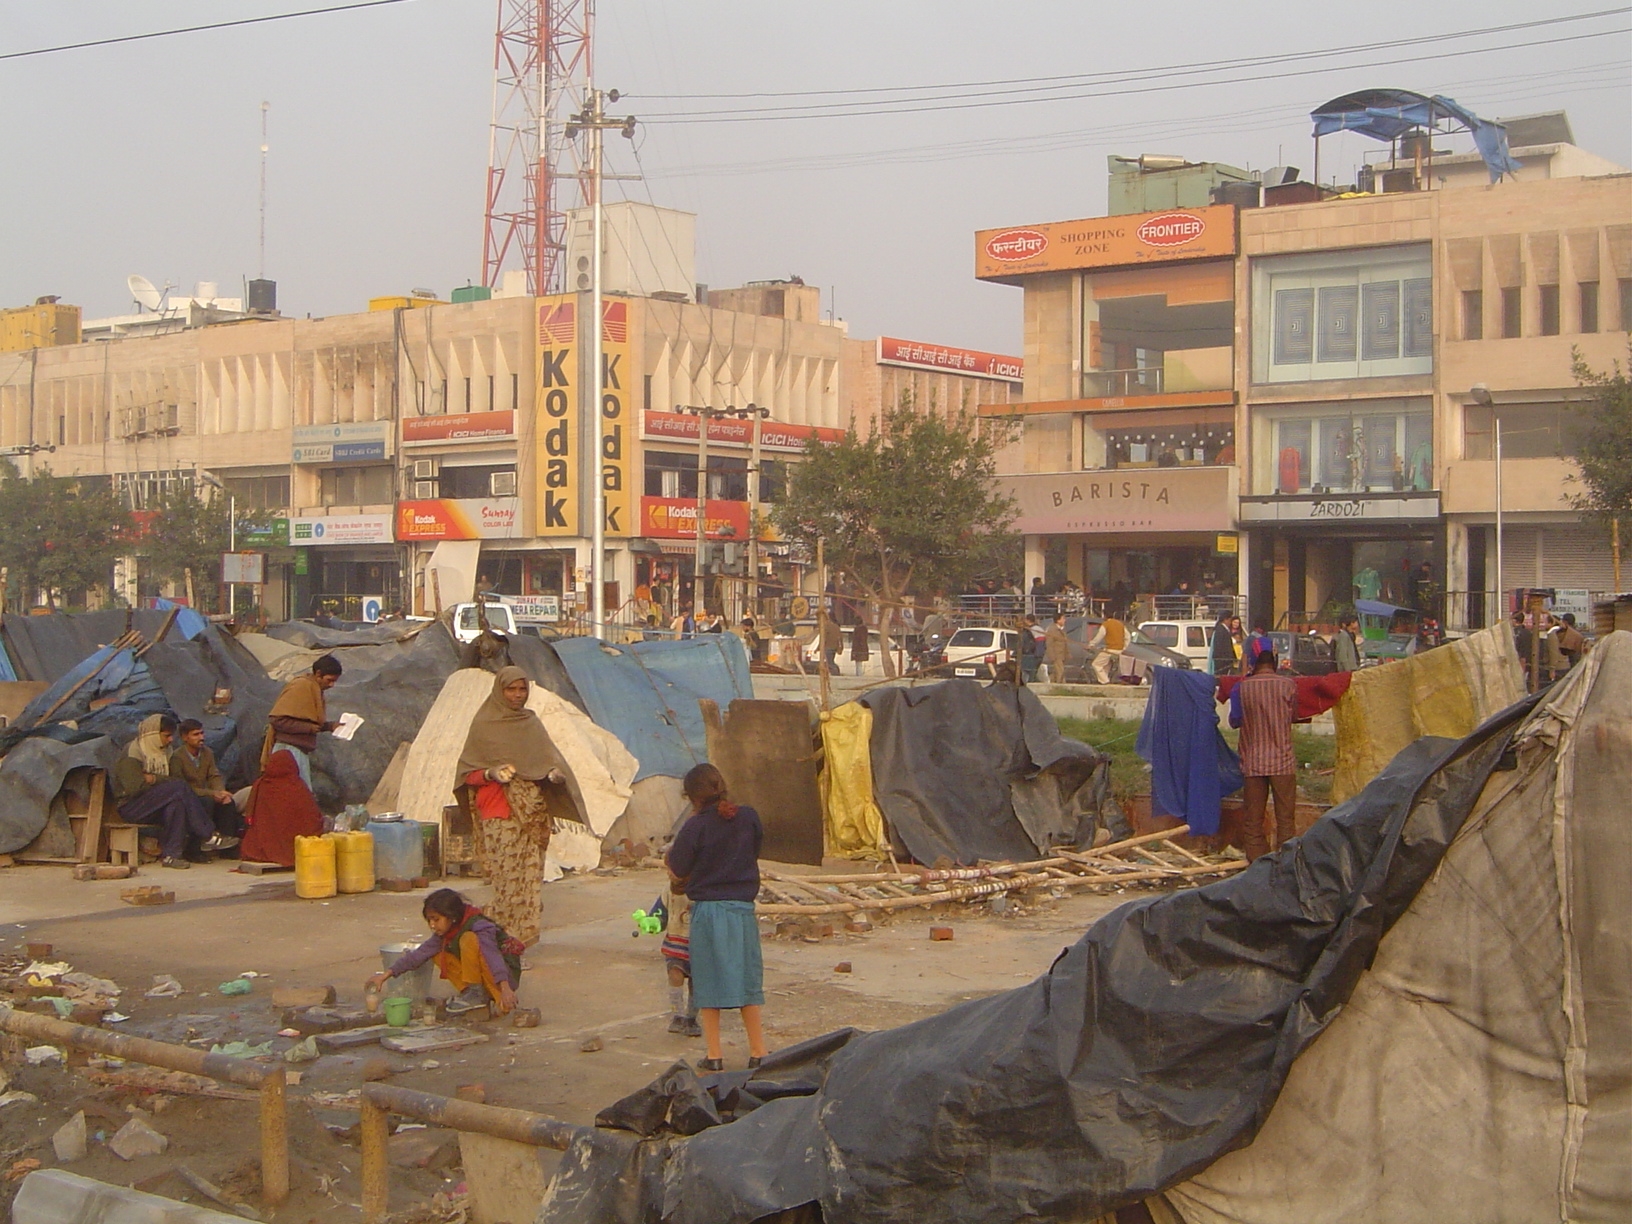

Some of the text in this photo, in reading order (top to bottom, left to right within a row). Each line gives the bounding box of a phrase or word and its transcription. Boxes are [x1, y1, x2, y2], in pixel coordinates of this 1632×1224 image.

[1060, 228, 1125, 244] SHOPPING
[1141, 221, 1200, 239] FRONTIER
[1075, 243, 1110, 255] ZONE
[996, 364, 1020, 376] ICICI
[485, 428, 506, 436] Finance
[542, 349, 569, 528] Kodak
[602, 353, 621, 532] Kodak
[761, 433, 786, 445] ICICI
[787, 435, 807, 447] Hom
[315, 448, 331, 456] Card
[1052, 482, 1169, 507] BARISTA
[668, 505, 698, 518] Kodak
[1310, 502, 1365, 517] ZARDOZI
[415, 515, 436, 524] Kodak
[677, 517, 731, 531] EXRESS
[409, 523, 446, 533] EXPRESS
[530, 604, 557, 615] REPAIR
